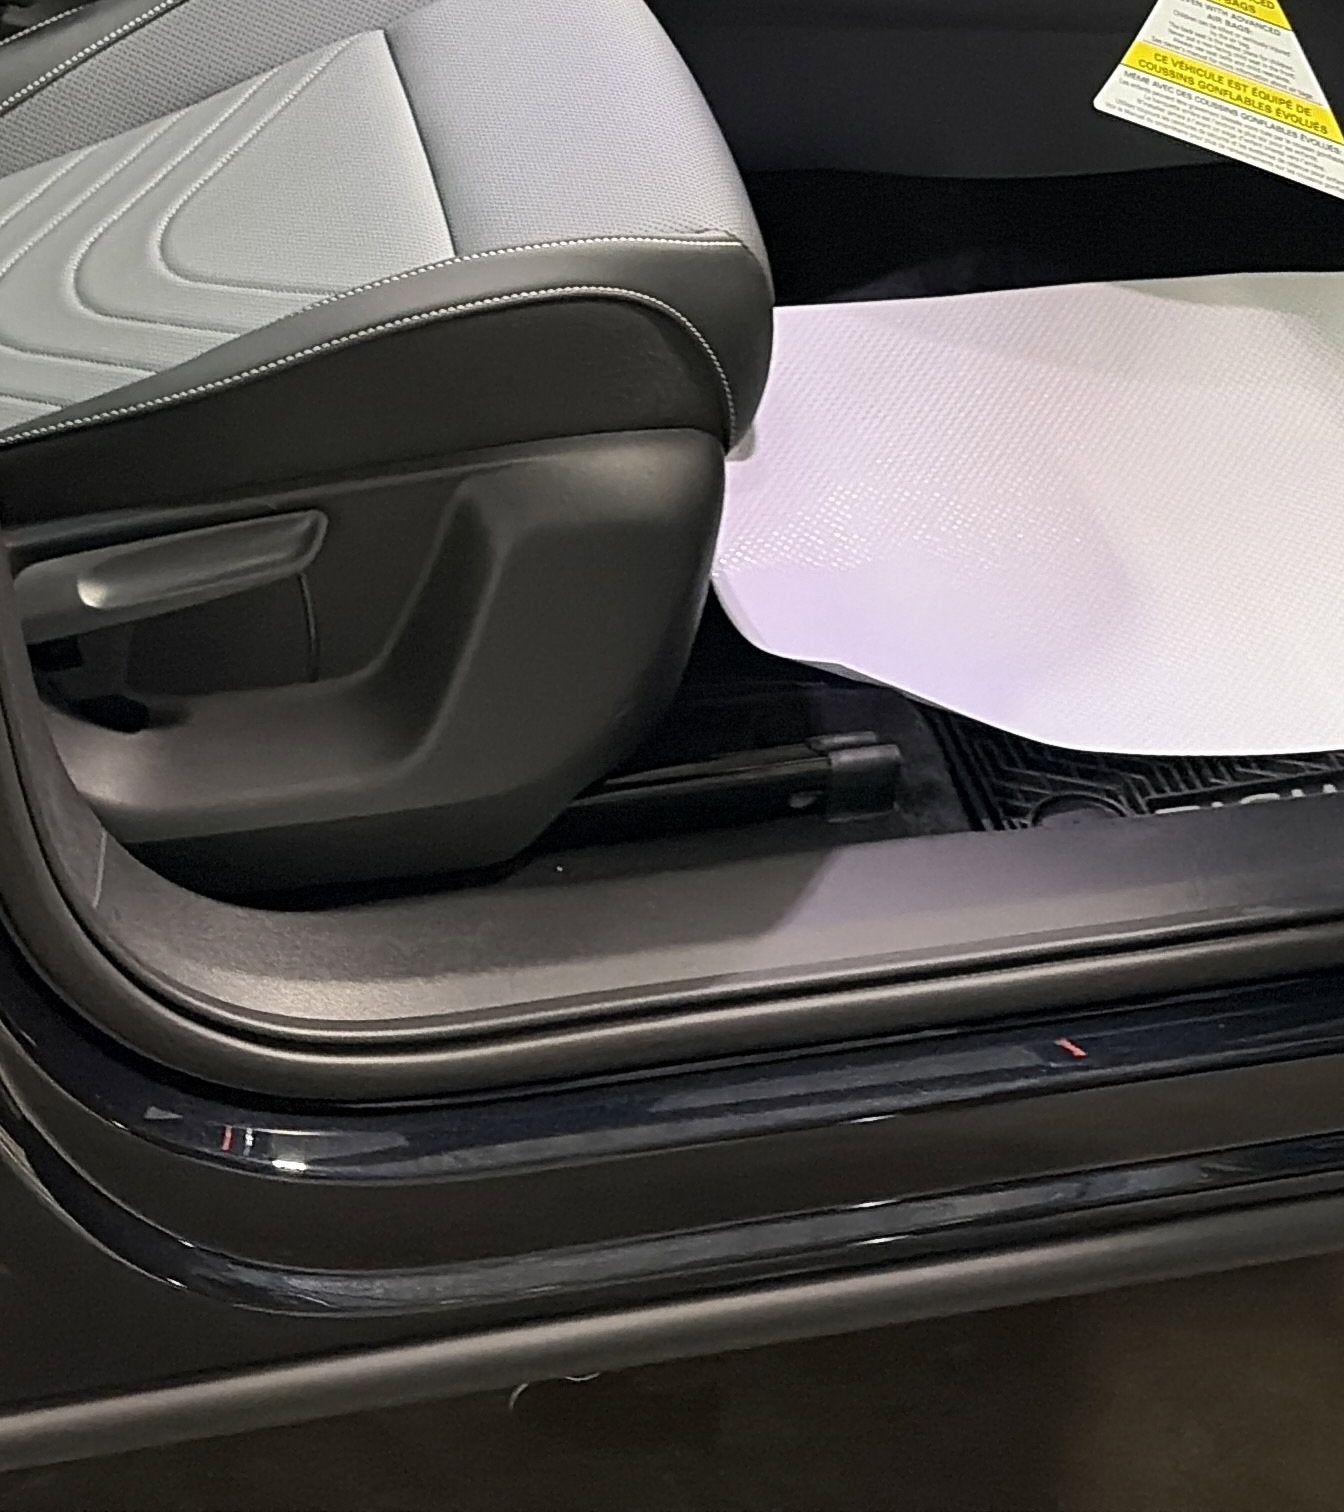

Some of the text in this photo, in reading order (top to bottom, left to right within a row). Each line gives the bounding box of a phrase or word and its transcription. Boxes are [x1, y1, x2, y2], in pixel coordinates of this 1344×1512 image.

[1205, 4, 1228, 16] WITH
[1231, 13, 1281, 36] ADVANCED
[1207, 13, 1222, 24] AIR
[1138, 59, 1328, 135] COUSSINS GONFLABLES ÉVOLUÉS
[1152, 81, 1174, 94] AVEC
[1175, 89, 1193, 100] DES
[1194, 96, 1238, 117] COUSSINS
[1240, 112, 1297, 138] GONFLABLES
[1153, 52, 1312, 117] CE VÉHICULE EST ÉQUIPÉ DE
